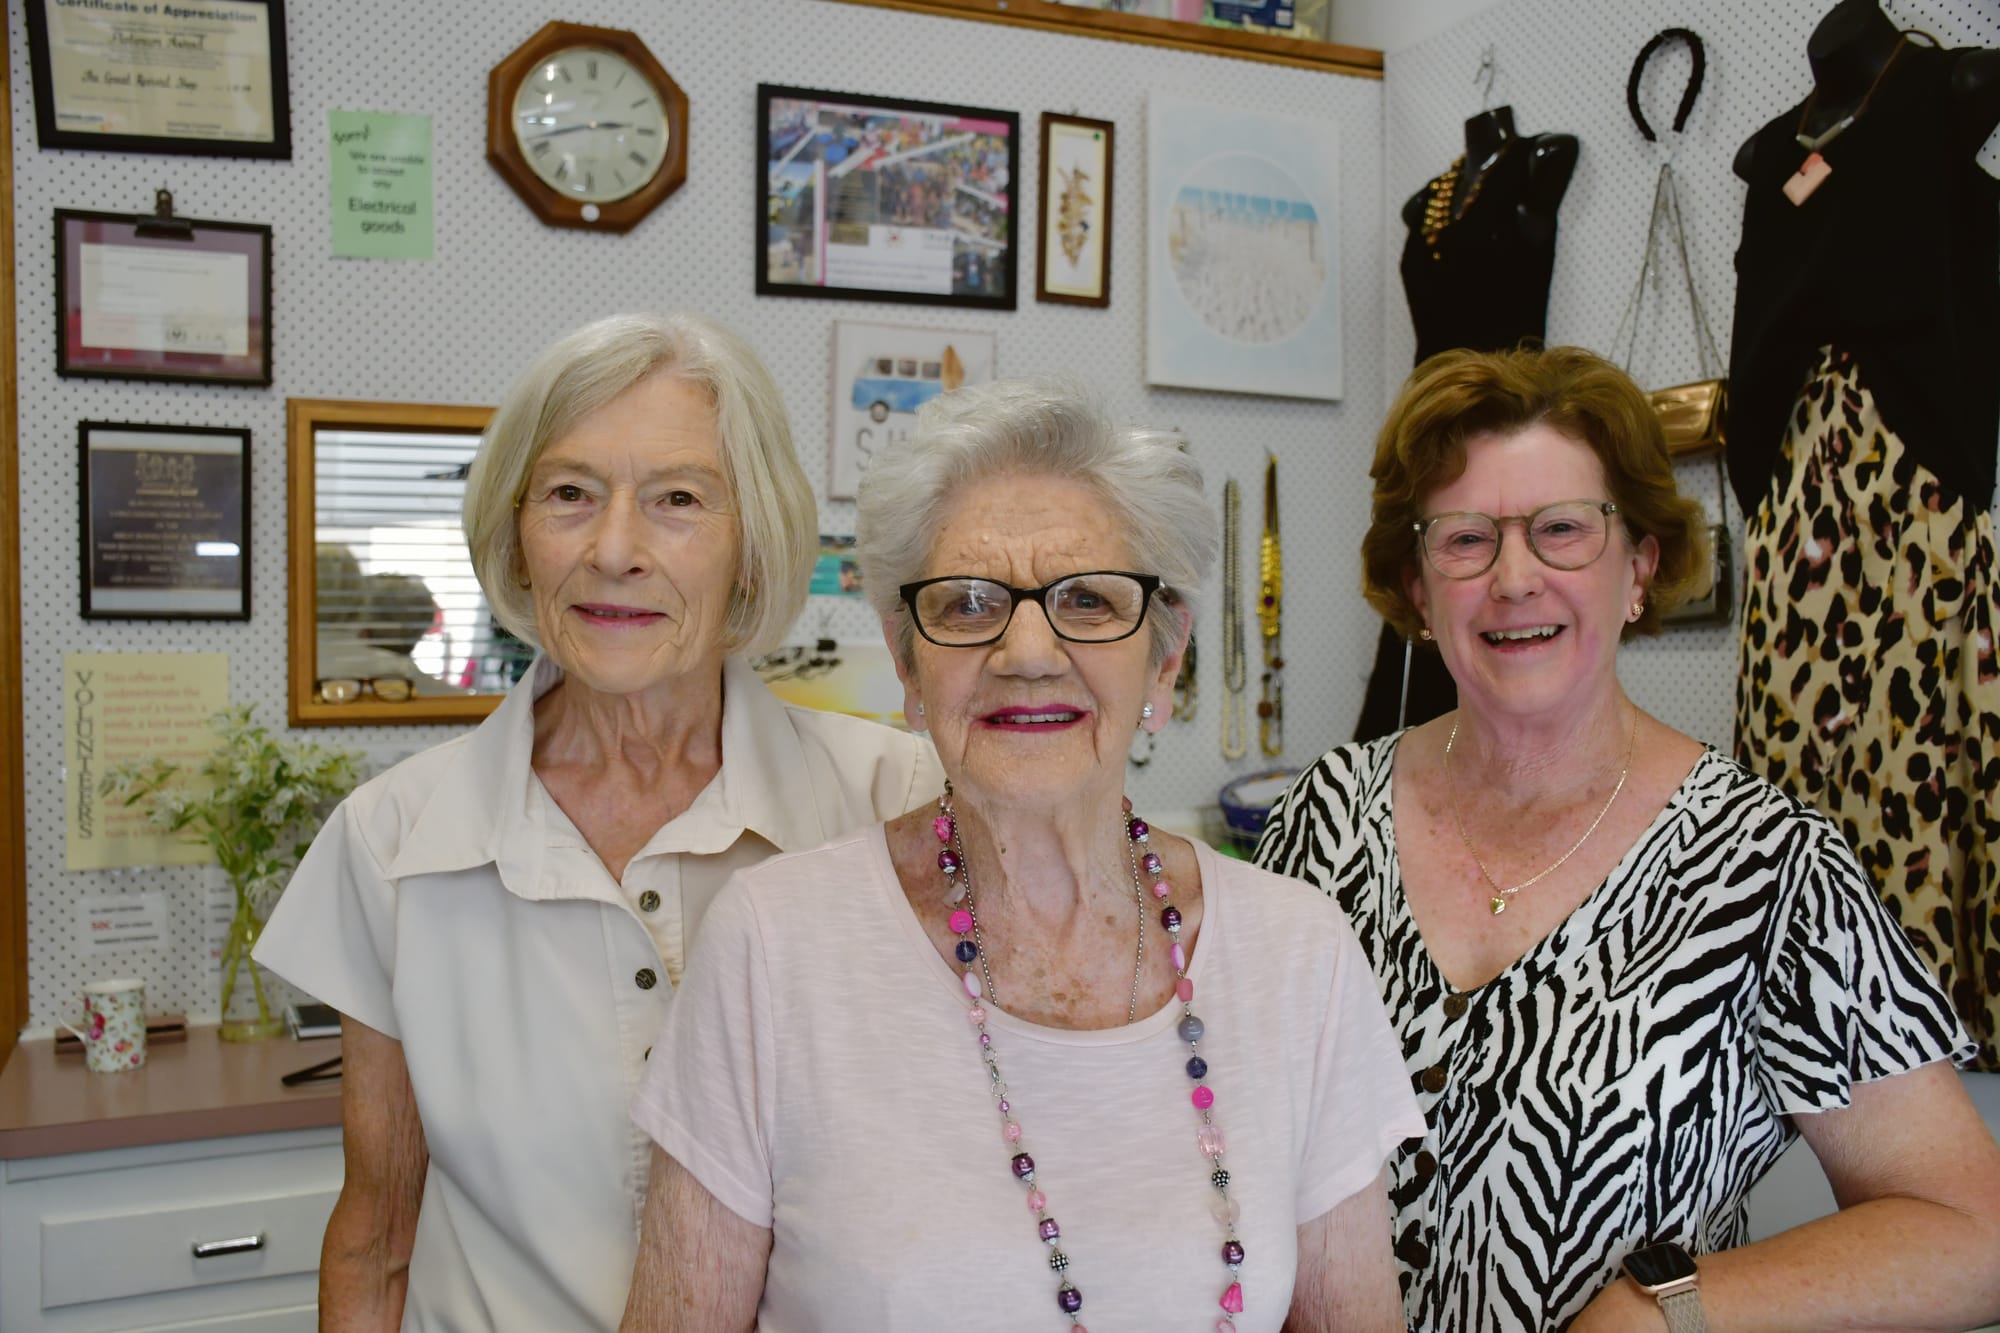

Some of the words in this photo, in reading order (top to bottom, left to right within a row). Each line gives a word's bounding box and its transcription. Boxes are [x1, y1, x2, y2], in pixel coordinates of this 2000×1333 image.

[56, 0, 138, 14] Certificate
[143, 4, 158, 14] of
[163, 5, 258, 23] Appreciation
[347, 196, 418, 216] Electrical
[360, 219, 406, 235] goods
[74, 669, 95, 840] VOLUNTEERS
